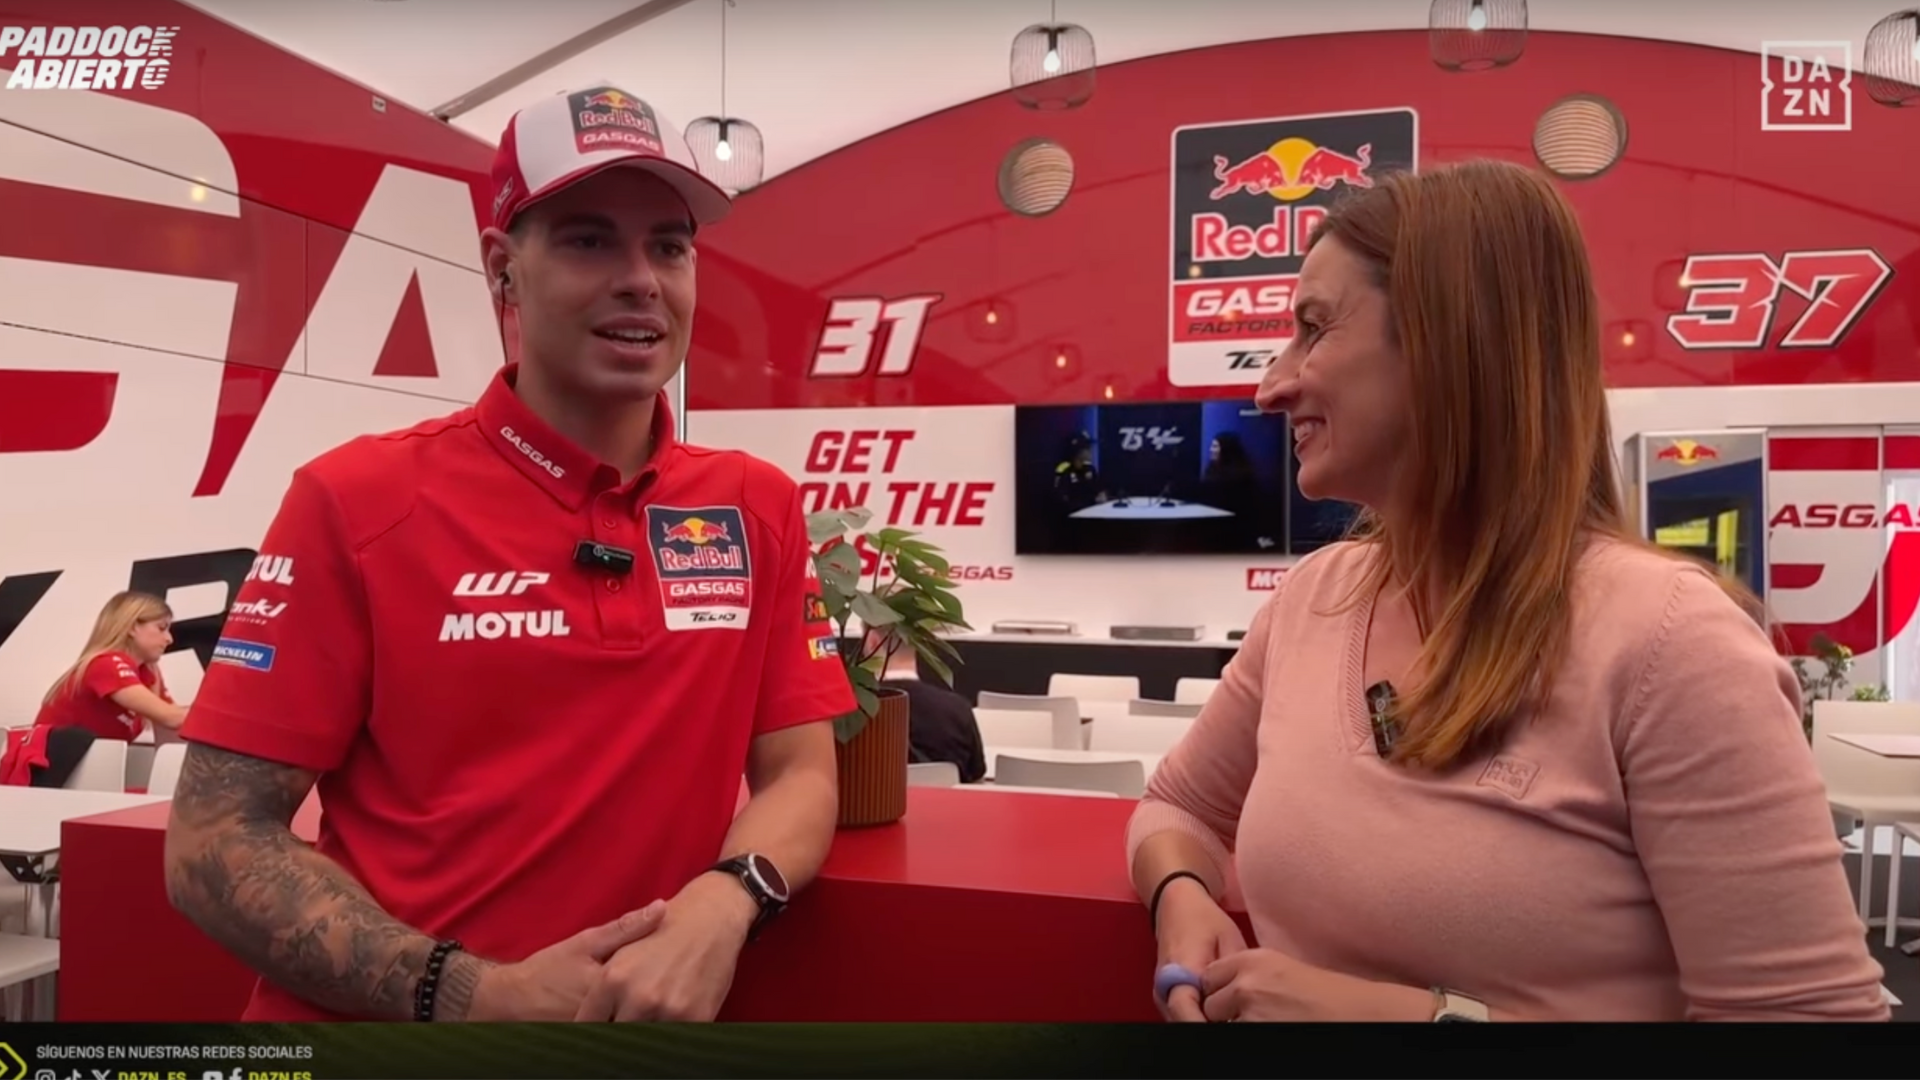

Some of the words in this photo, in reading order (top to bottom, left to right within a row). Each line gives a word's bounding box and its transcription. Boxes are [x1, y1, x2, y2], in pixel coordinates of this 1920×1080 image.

[579, 108, 621, 128] Red
[620, 108, 656, 136] Bull
[583, 132, 660, 152] GASGAS
[1192, 205, 1291, 262] Red
[1186, 286, 1296, 317] GAS
[1666, 248, 1896, 350] 37
[809, 293, 944, 379] 31
[500, 426, 566, 478] GASGAS
[805, 430, 916, 474] GET
[886, 483, 995, 526] THE
[1769, 503, 1920, 529] ASGA
[659, 545, 706, 571] Red
[703, 545, 743, 570] Bull
[947, 565, 1013, 581] SGAS
[670, 582, 745, 597] GASGAS
[439, 610, 570, 642] MOTUL
